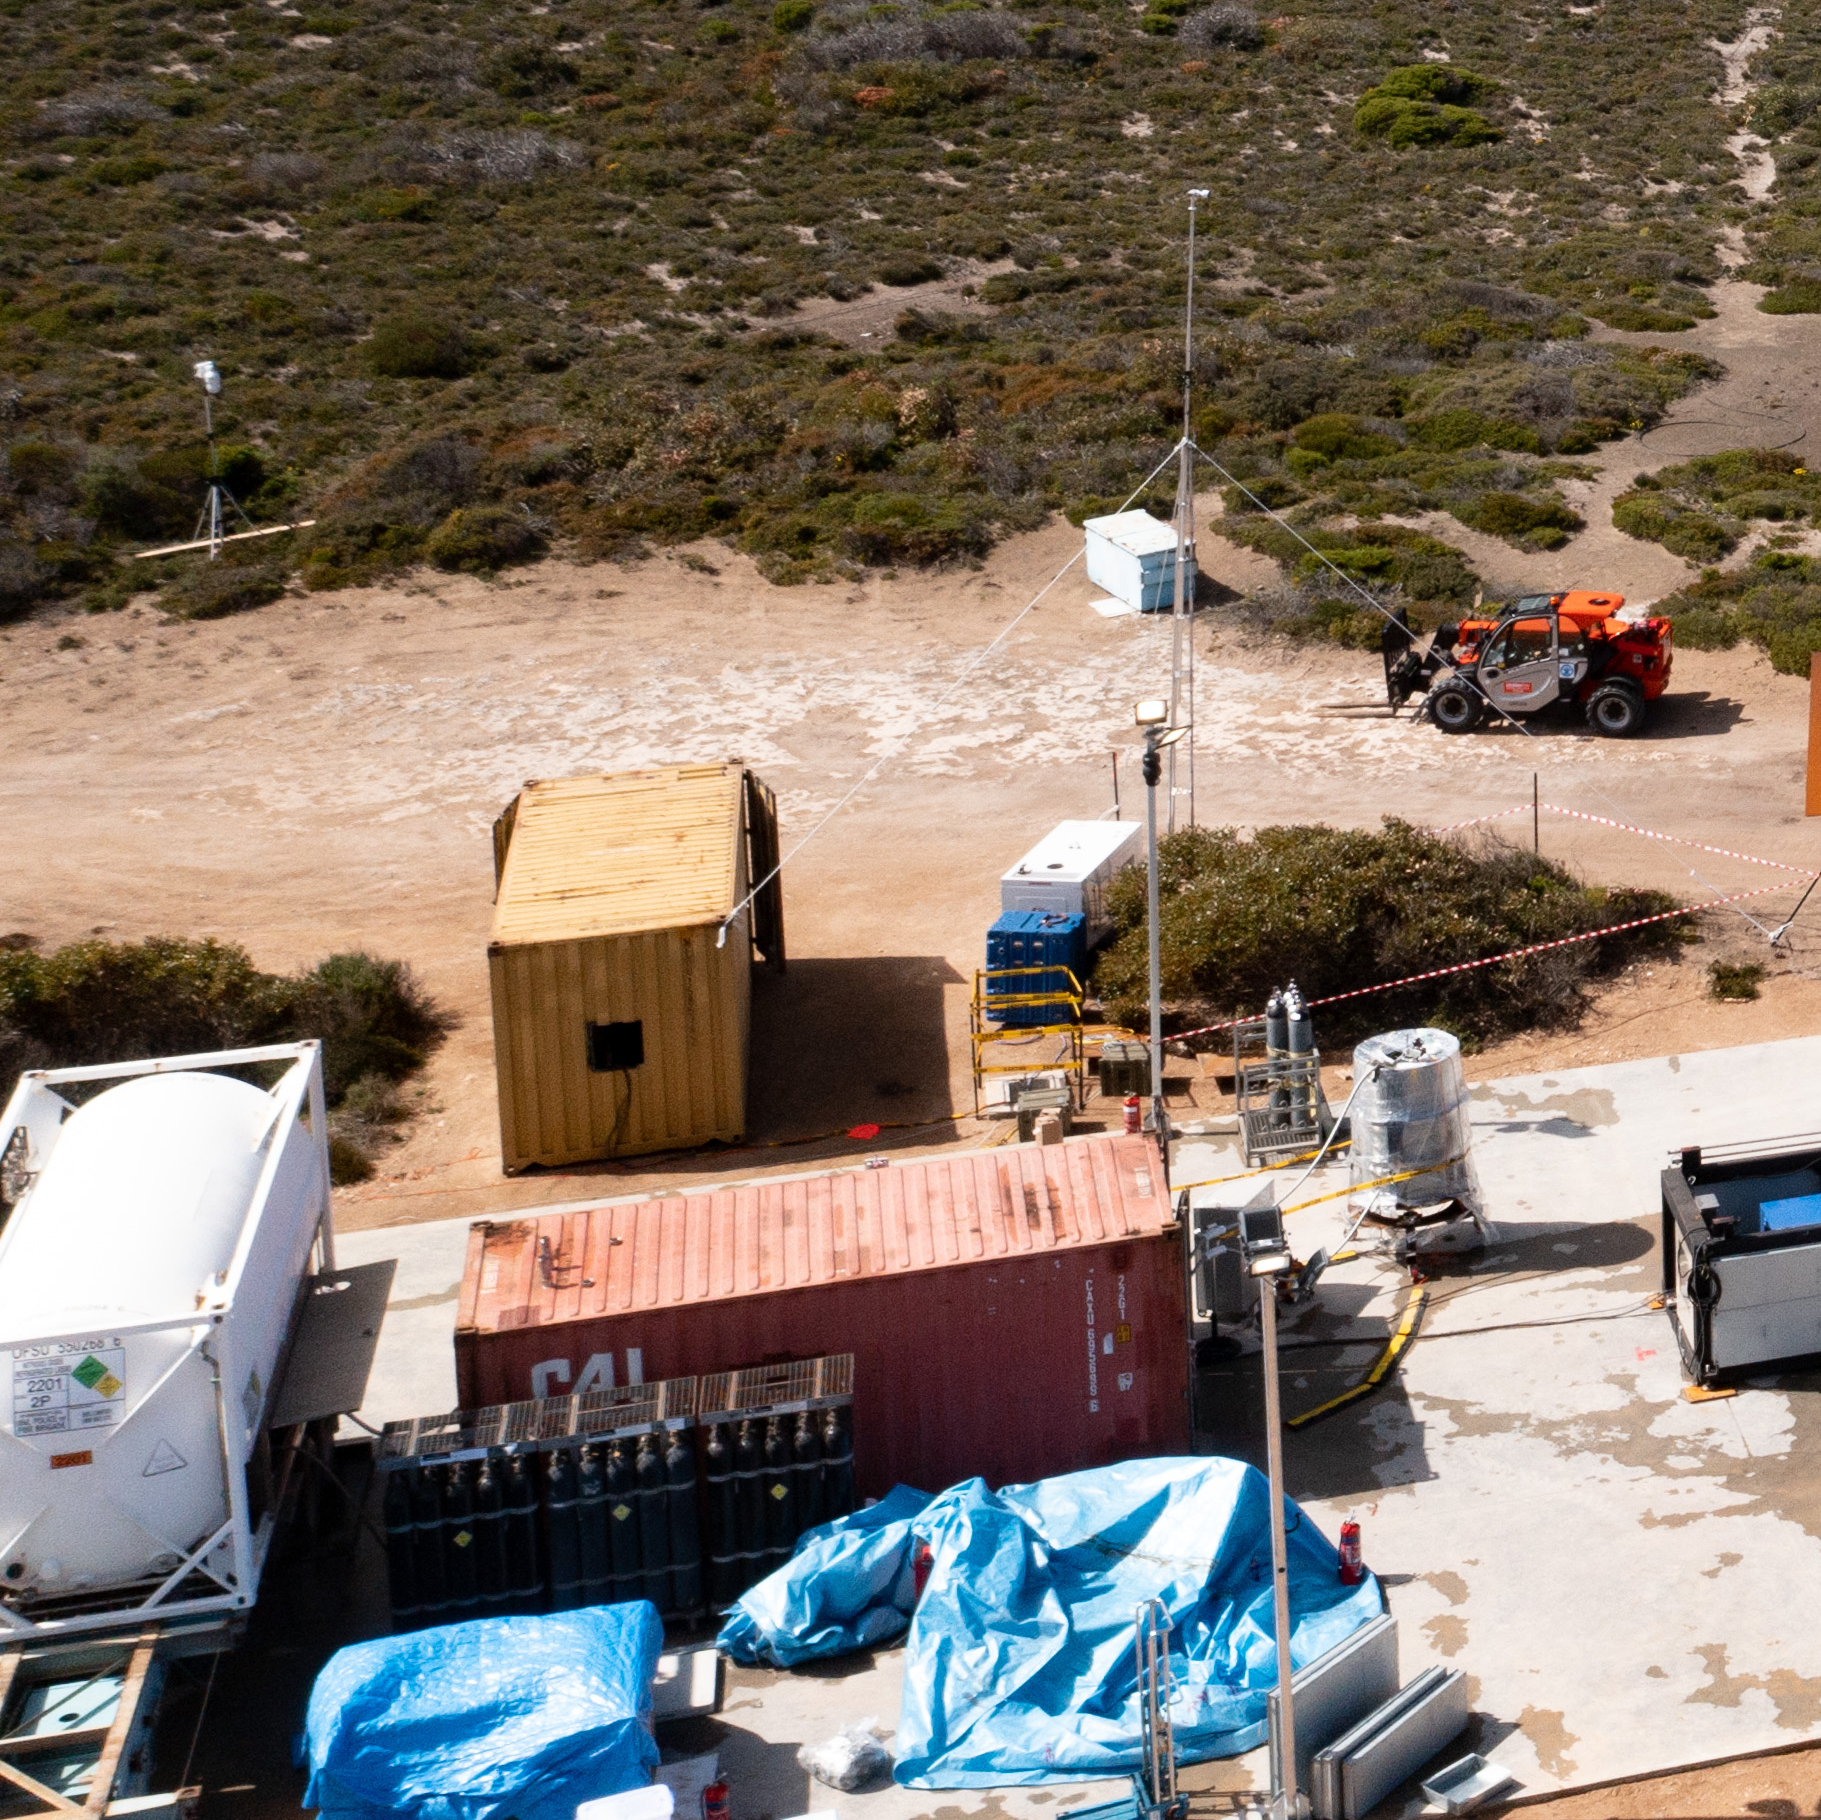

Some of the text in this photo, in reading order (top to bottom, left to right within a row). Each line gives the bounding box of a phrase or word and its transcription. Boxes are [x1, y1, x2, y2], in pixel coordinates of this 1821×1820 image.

[1086, 1279, 1095, 1325] CAXU
[1118, 1275, 1126, 1320] 22G1
[27, 1377, 62, 1393] 2201
[30, 1395, 51, 1408] 2P
